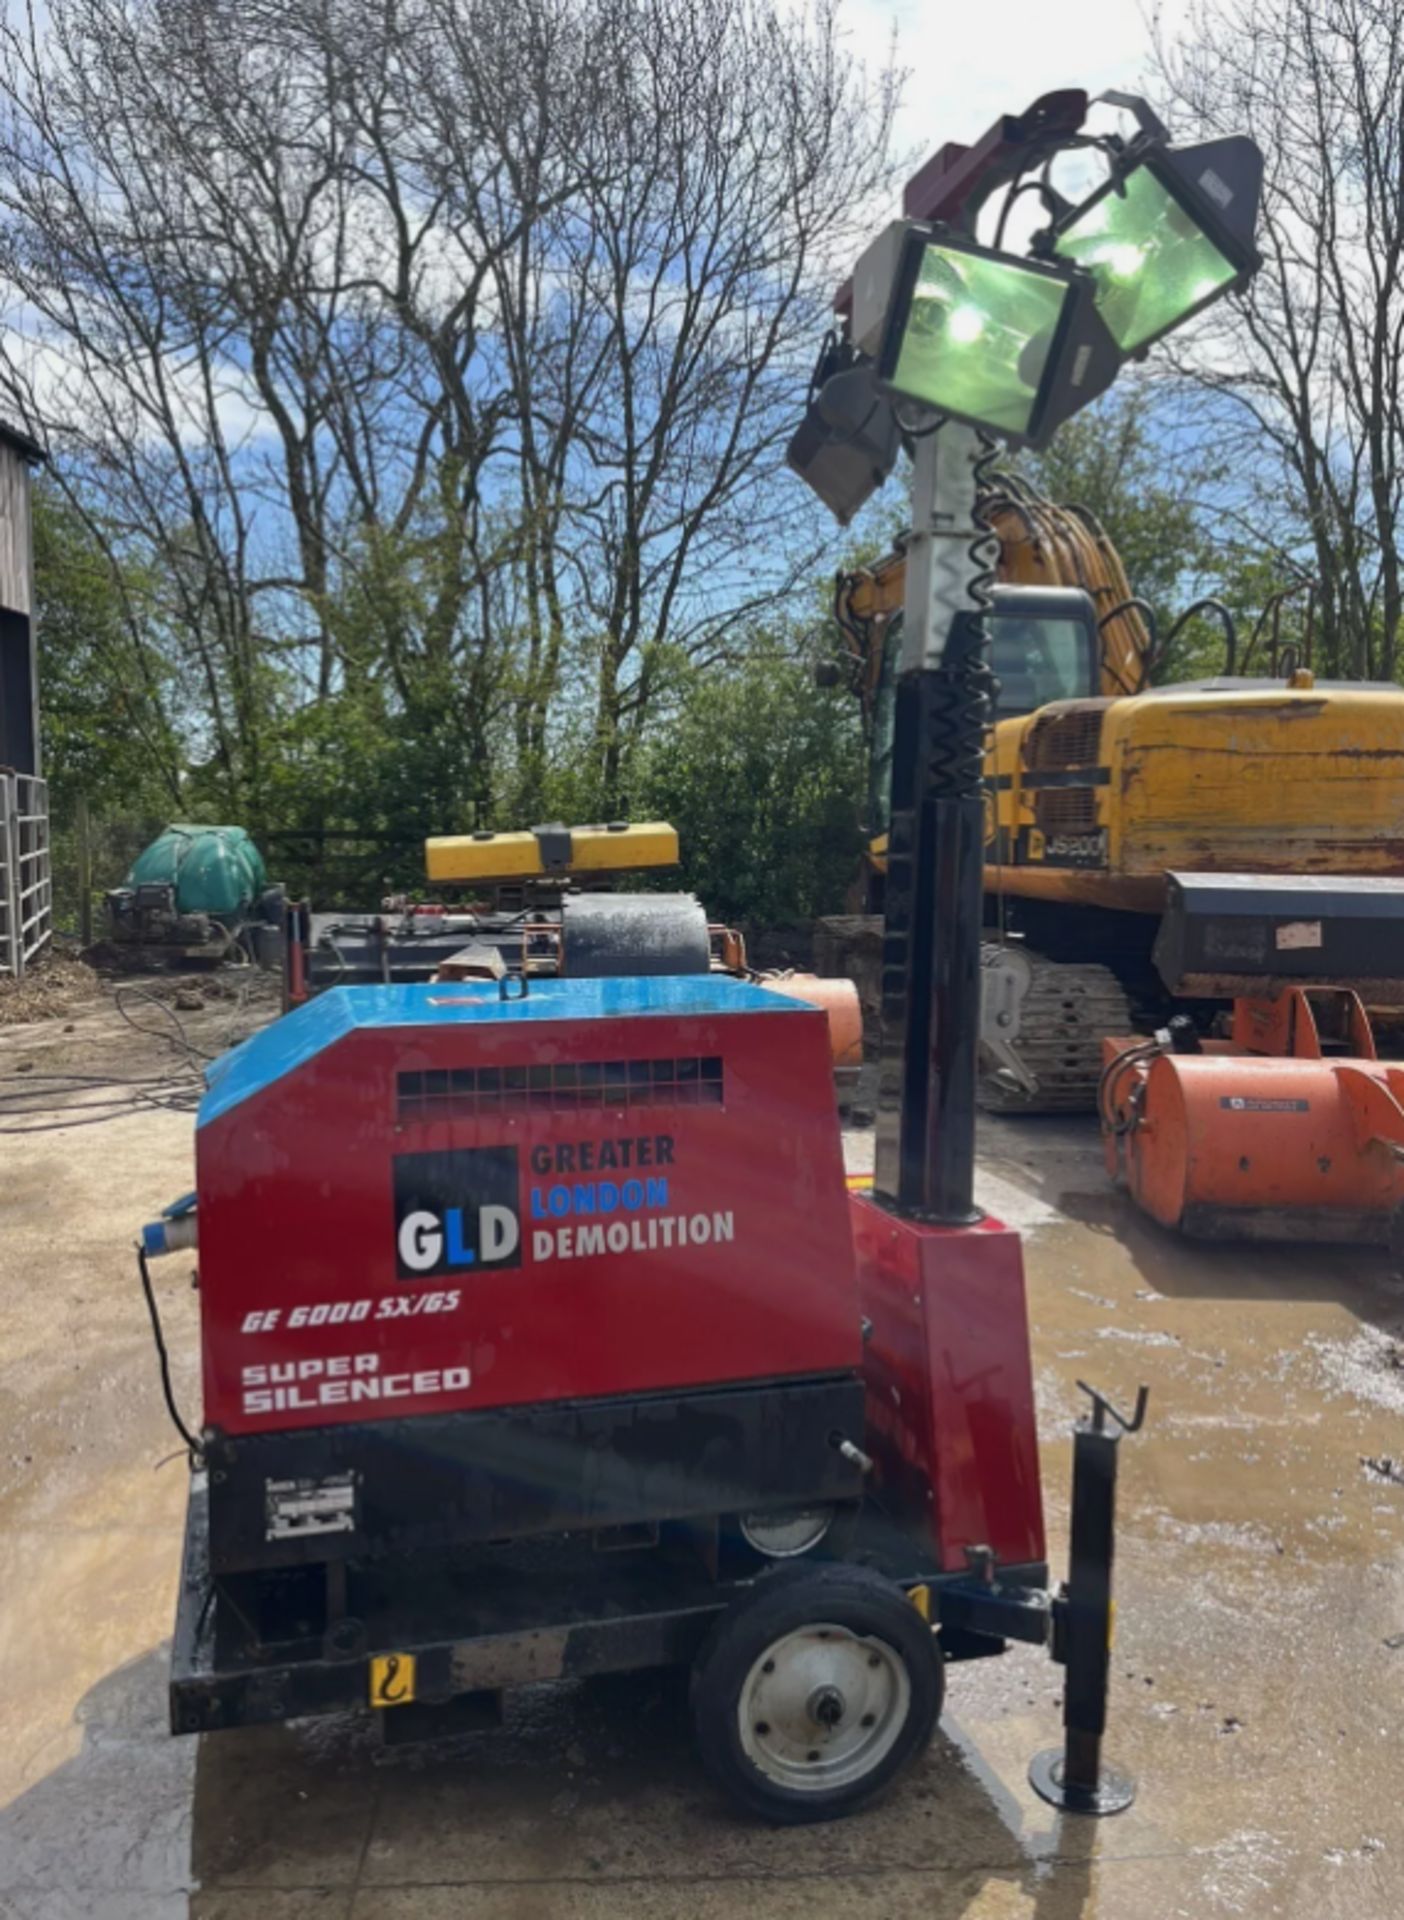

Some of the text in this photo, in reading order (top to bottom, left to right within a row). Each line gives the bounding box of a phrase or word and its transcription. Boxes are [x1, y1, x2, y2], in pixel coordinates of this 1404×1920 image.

[531, 1135, 676, 1176] GREATER
[531, 1177, 669, 1219] LONDON
[398, 1205, 520, 1271] GLD
[533, 1211, 735, 1262] DEMOLITION
[241, 1309, 281, 1334] GE
[287, 1300, 372, 1328] 6000
[242, 1354, 379, 1386] SUPER
[243, 1367, 471, 1415] SILENCED
